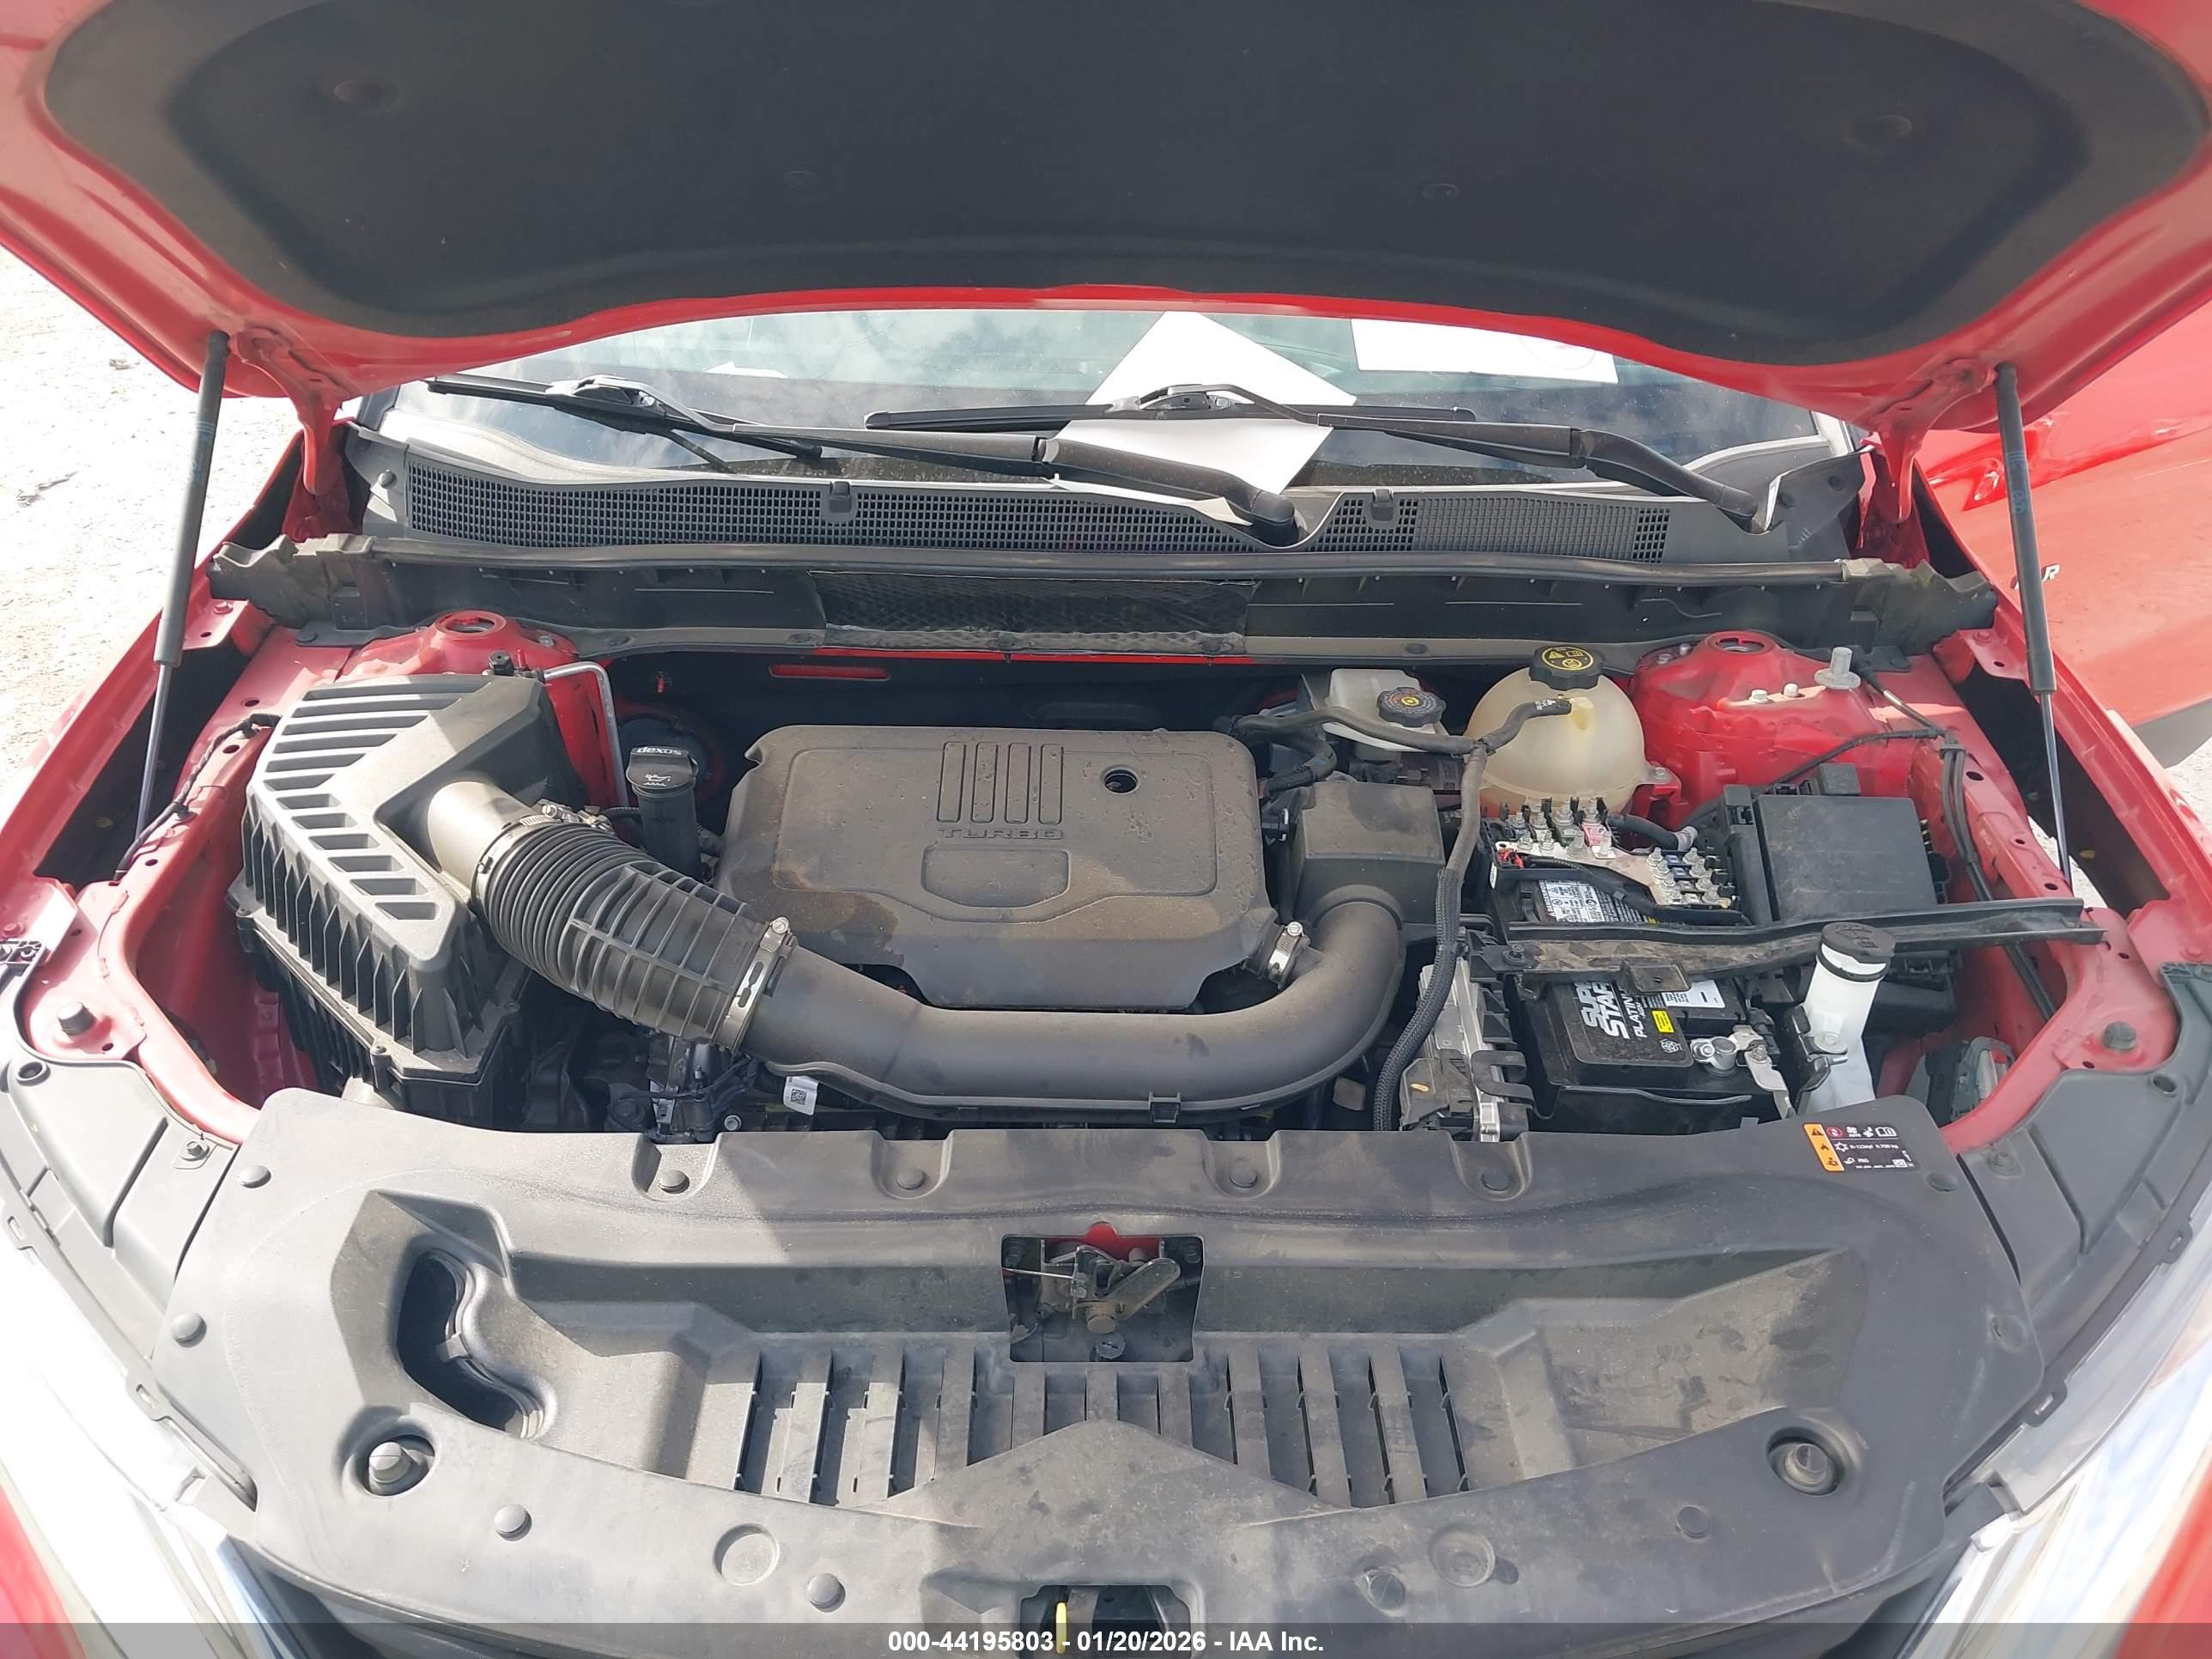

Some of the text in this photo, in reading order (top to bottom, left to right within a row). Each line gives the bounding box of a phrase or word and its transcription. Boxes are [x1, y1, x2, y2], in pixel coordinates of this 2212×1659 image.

[636, 746, 682, 755] dexos
[938, 829, 1064, 840] TURBO
[1592, 981, 1631, 1040] STAR
